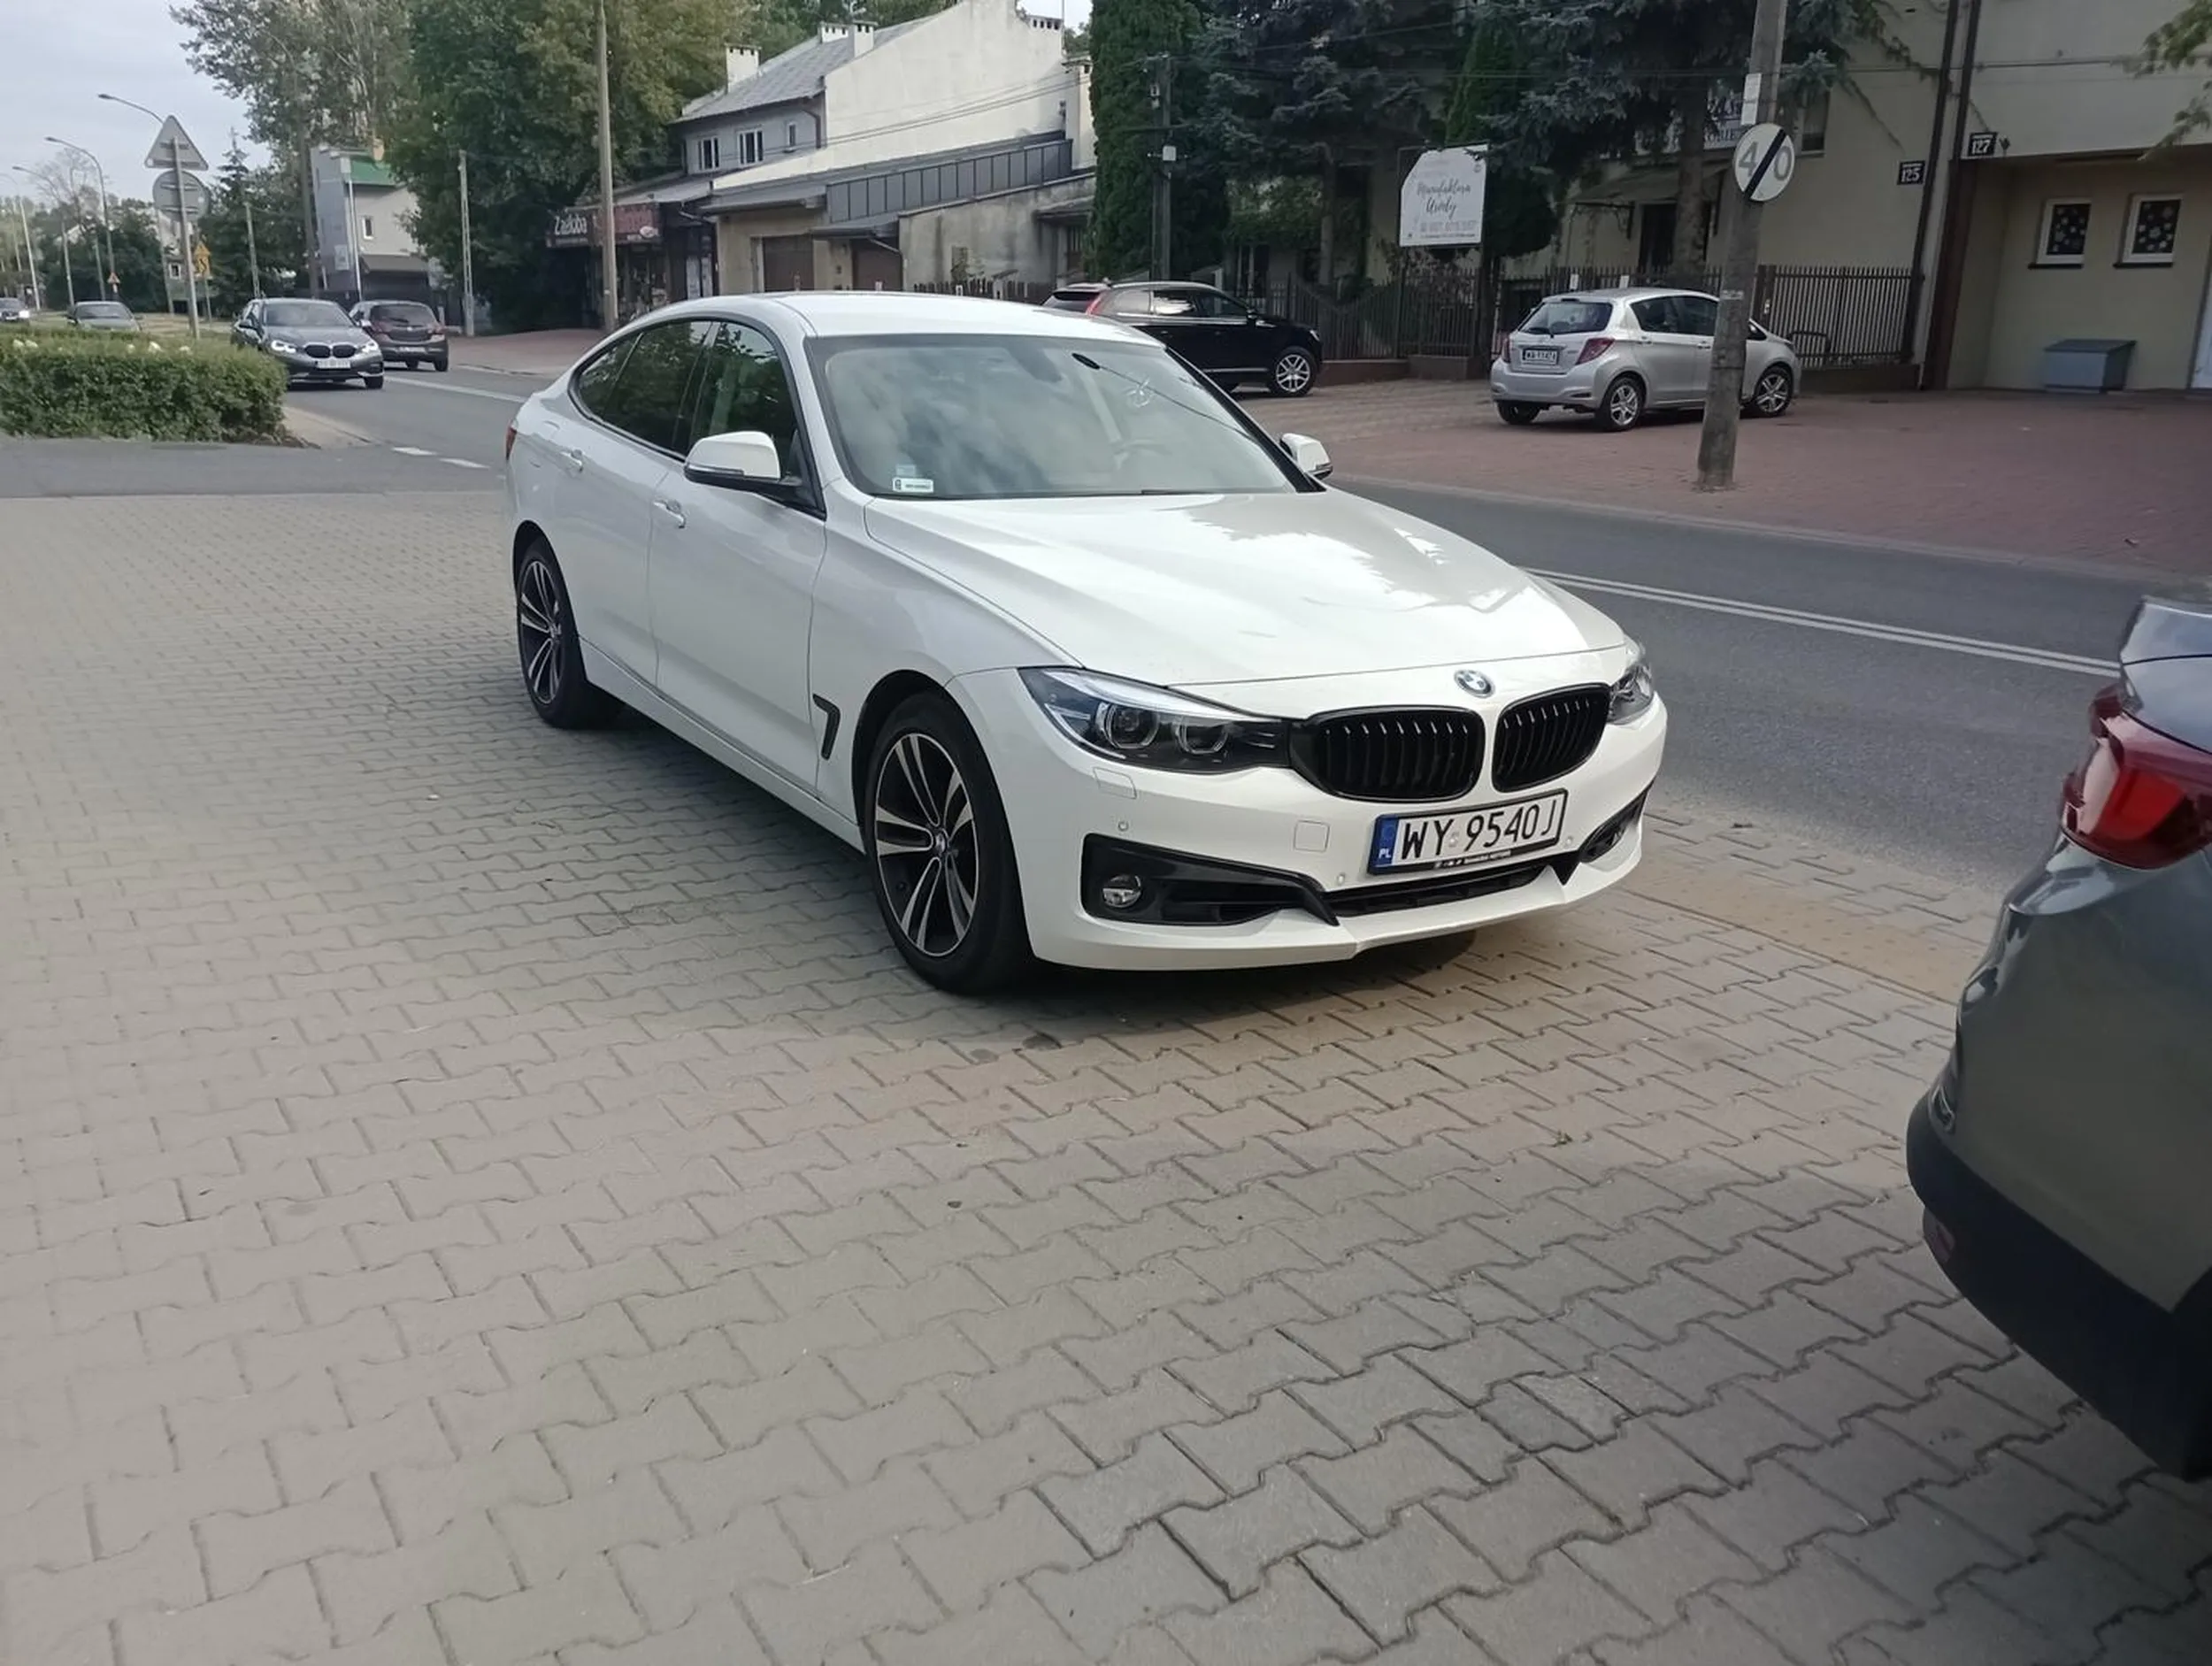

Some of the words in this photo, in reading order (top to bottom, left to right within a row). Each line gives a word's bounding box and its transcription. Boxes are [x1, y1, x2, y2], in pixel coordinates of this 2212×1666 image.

[1971, 139, 1991, 155] 127
[1901, 167, 1921, 182] 125
[1402, 818, 1455, 860] WY
[1464, 799, 1557, 852] 9540J
[1379, 848, 1392, 859] PL
